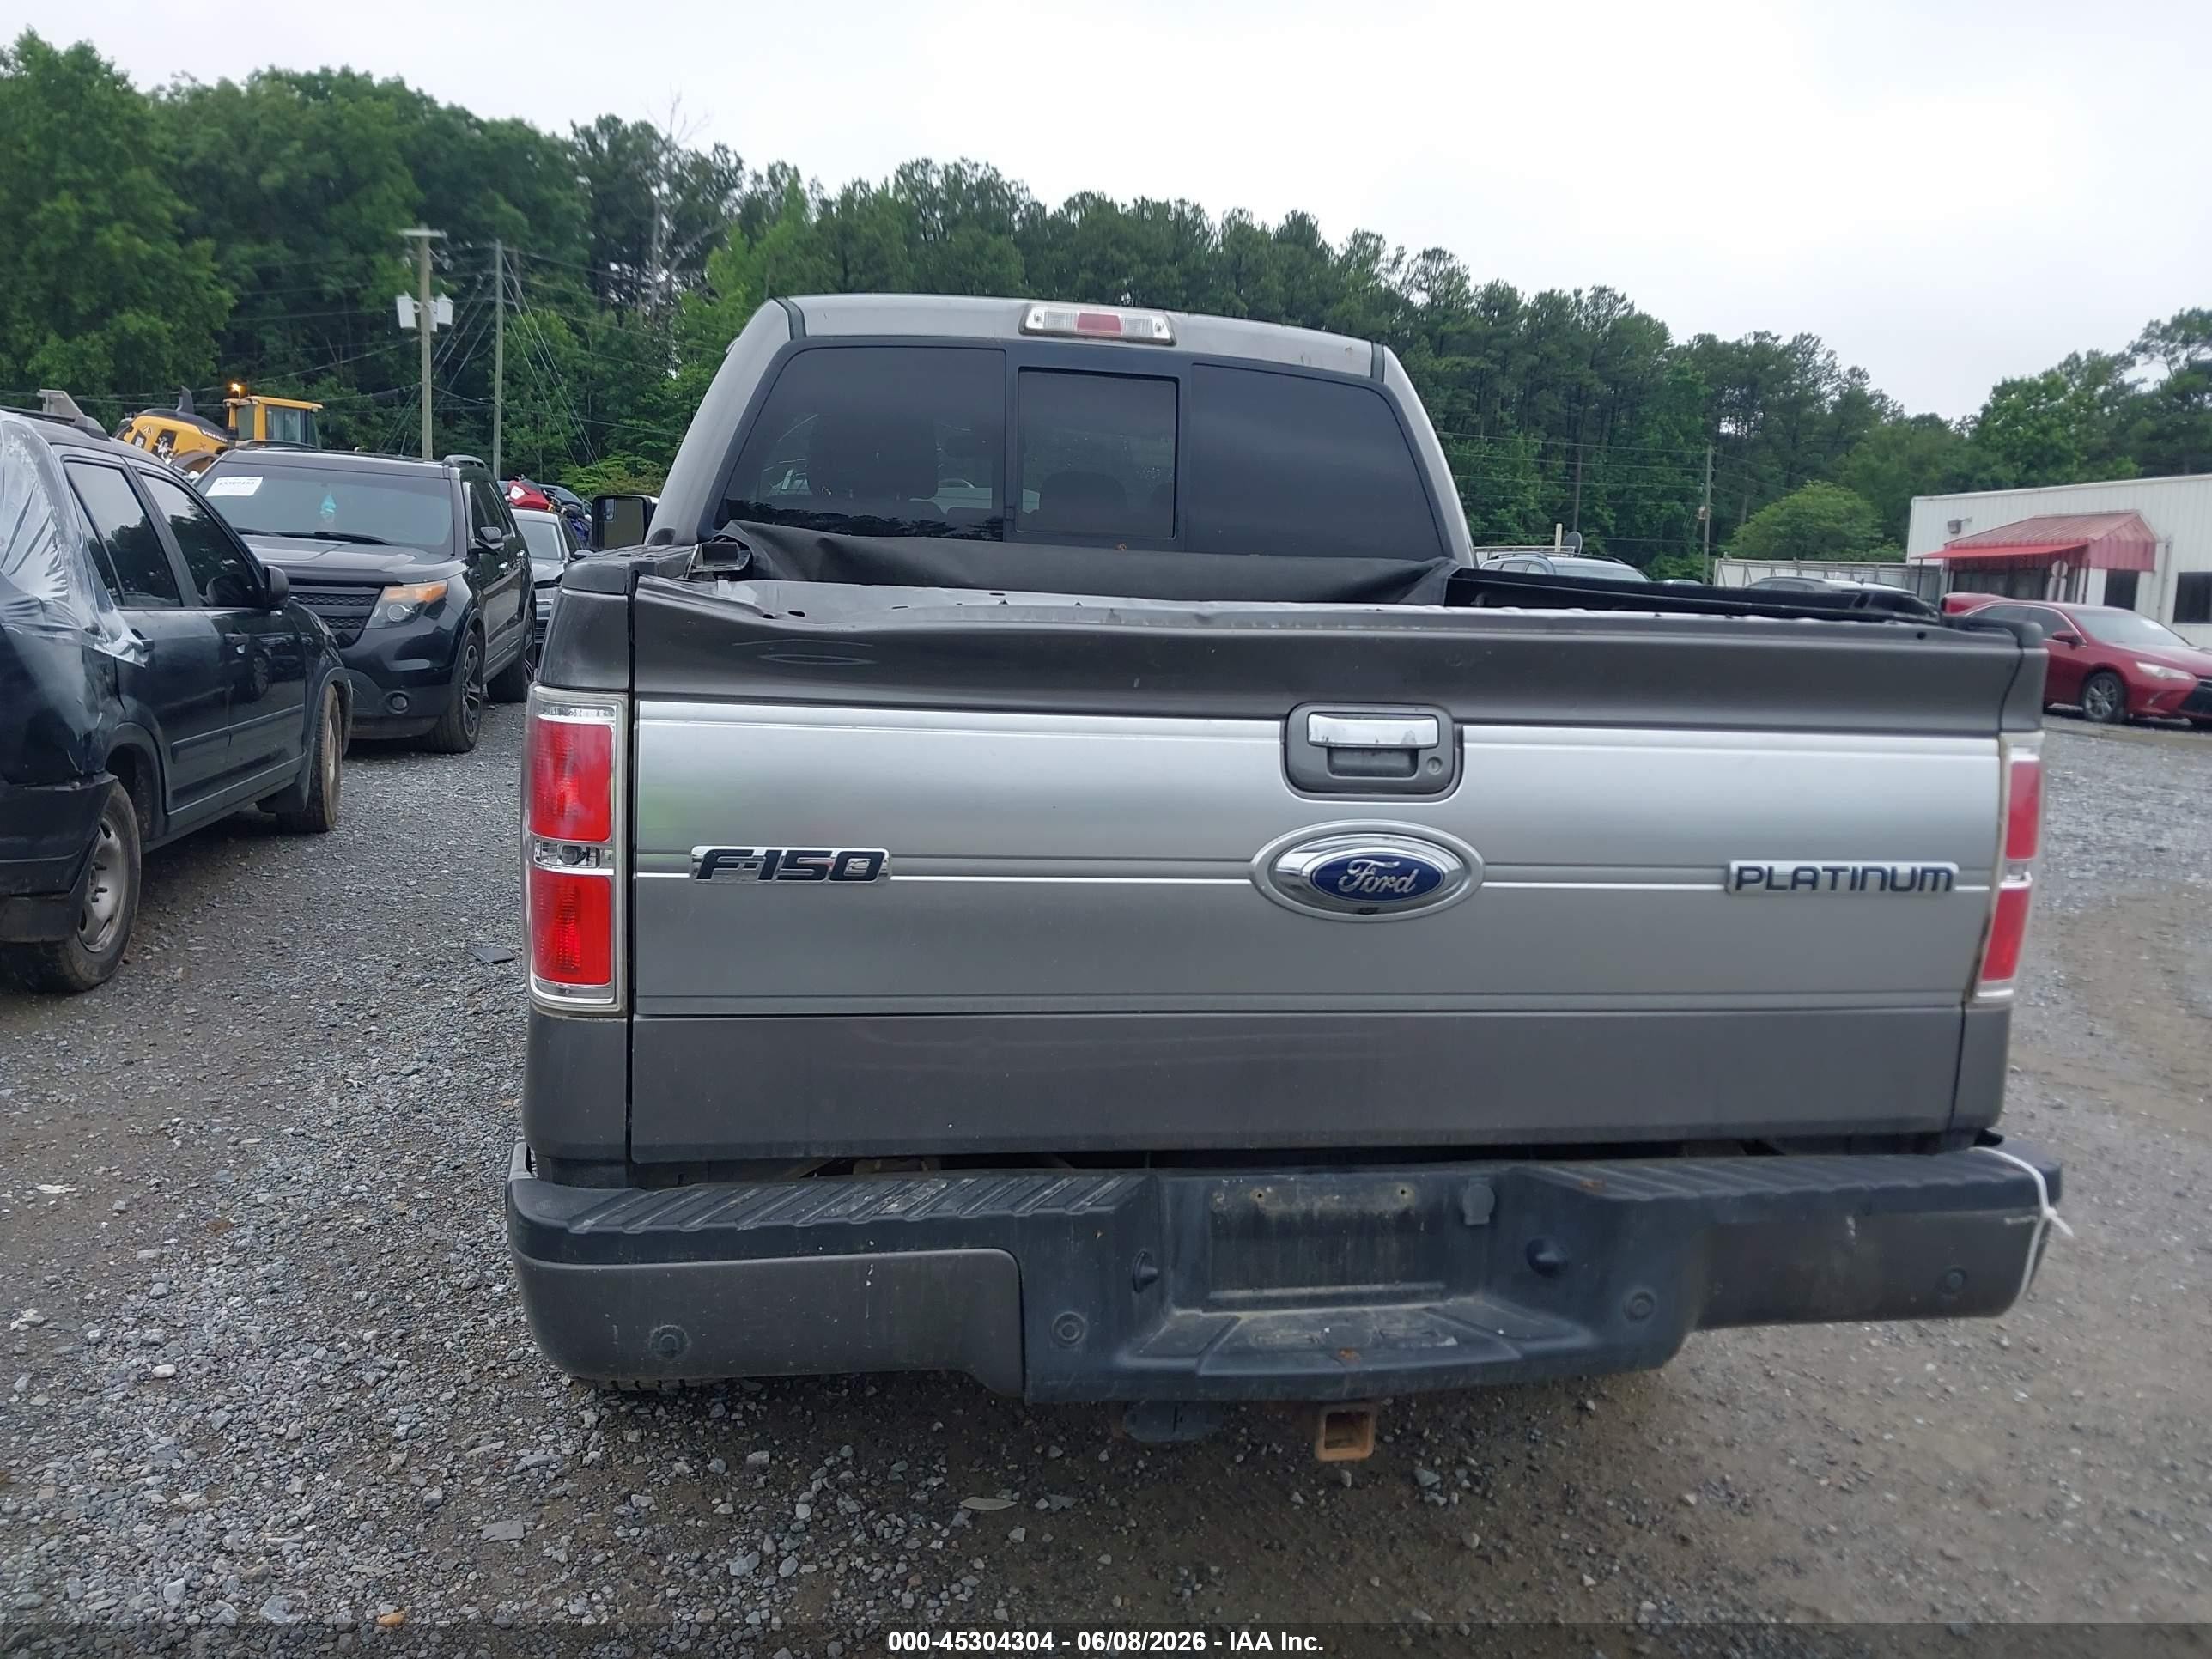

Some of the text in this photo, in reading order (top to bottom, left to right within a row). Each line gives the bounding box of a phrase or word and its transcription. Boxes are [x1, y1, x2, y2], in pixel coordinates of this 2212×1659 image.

[692, 846, 889, 883] F-150
[1337, 858, 1419, 894] Ford
[1734, 865, 1954, 893] PLATINUM
